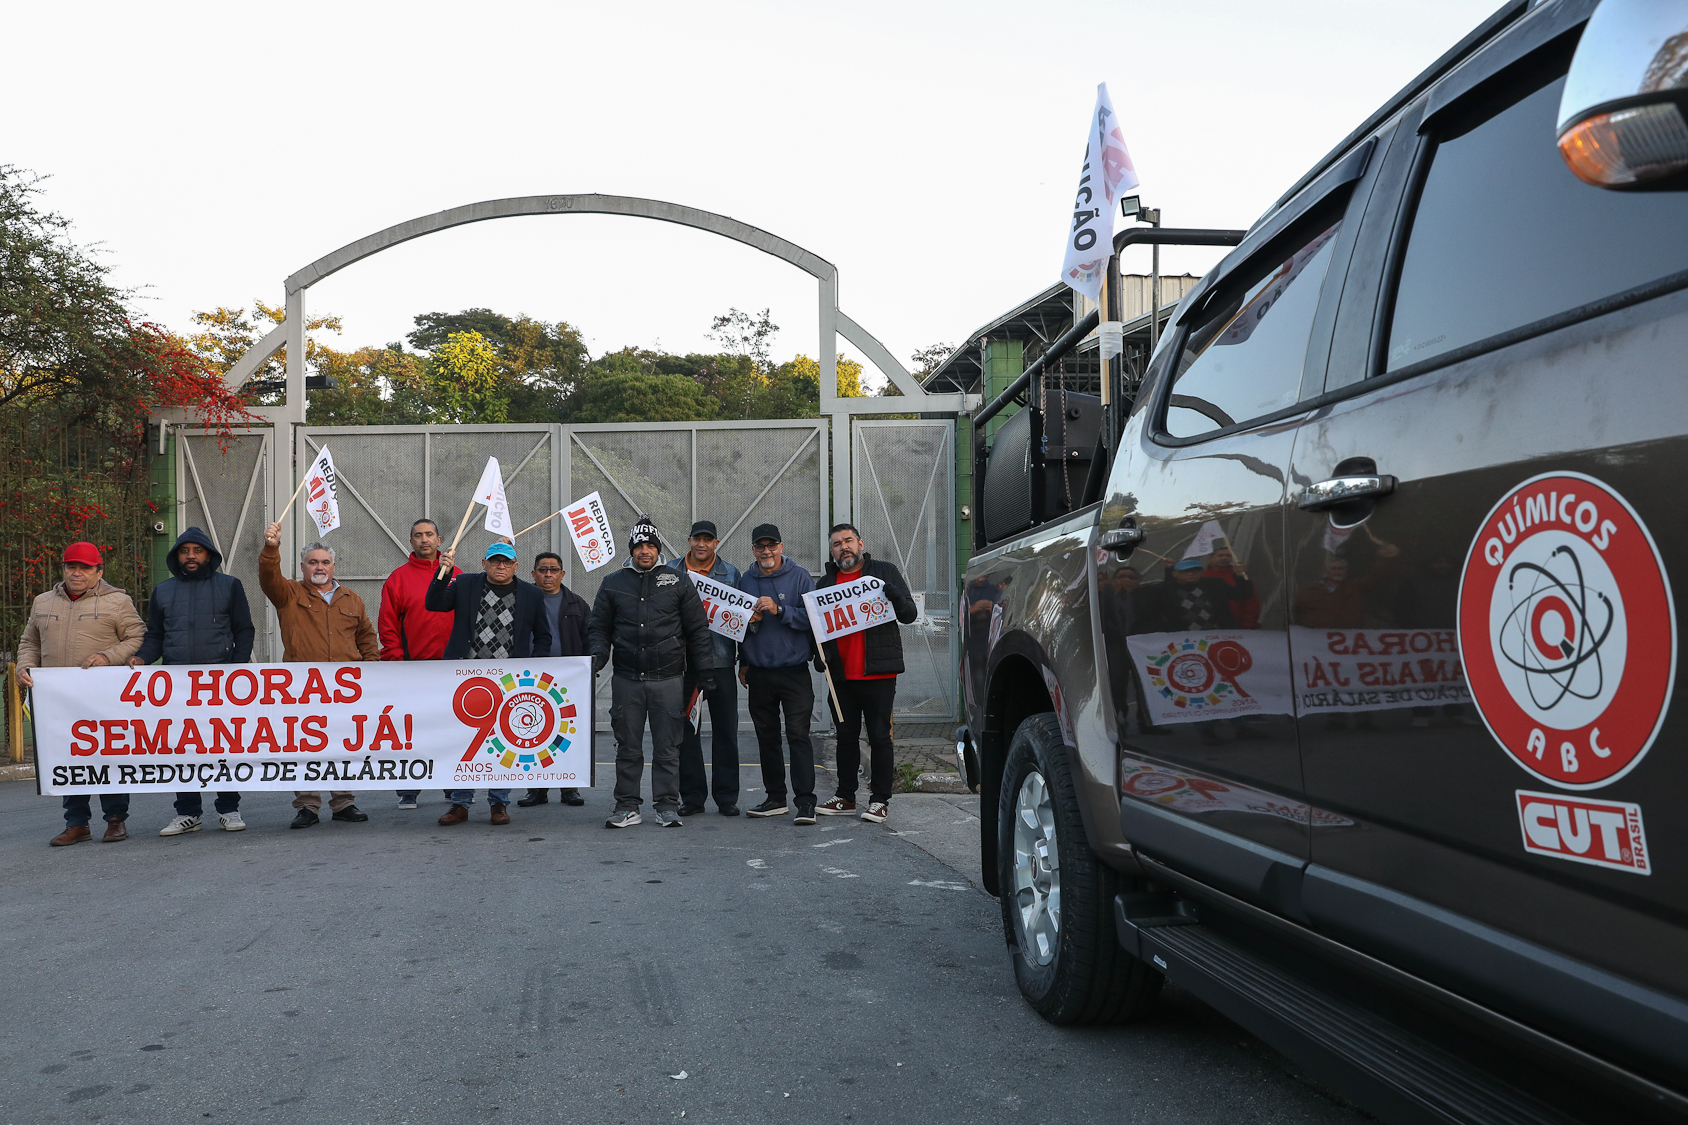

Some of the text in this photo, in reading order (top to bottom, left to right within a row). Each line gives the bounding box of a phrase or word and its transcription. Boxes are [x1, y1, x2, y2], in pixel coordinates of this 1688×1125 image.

[567, 506, 595, 539] JÁ!
[588, 499, 613, 556] REDUÇÃO
[1484, 491, 1618, 567] QUÍMICOS
[695, 580, 753, 610] REDUÇÃO
[816, 579, 880, 607] REDUÇÃO
[701, 597, 720, 624] Á!
[823, 603, 858, 634] JÁ!
[120, 666, 362, 708] 40 HORAS
[455, 668, 504, 677] RUMO AOS
[507, 693, 546, 709] QUÍMICOS
[70, 705, 413, 756] SEMANAIS JÁ!
[52, 756, 434, 788] SEM REDUÇÃO DE SALÁRIO!
[453, 772, 577, 782] CONSTRUINDO O FUTURO
[455, 762, 493, 773] ANOS
[1523, 801, 1626, 862] CUT
[1628, 808, 1647, 869] BRASIL
